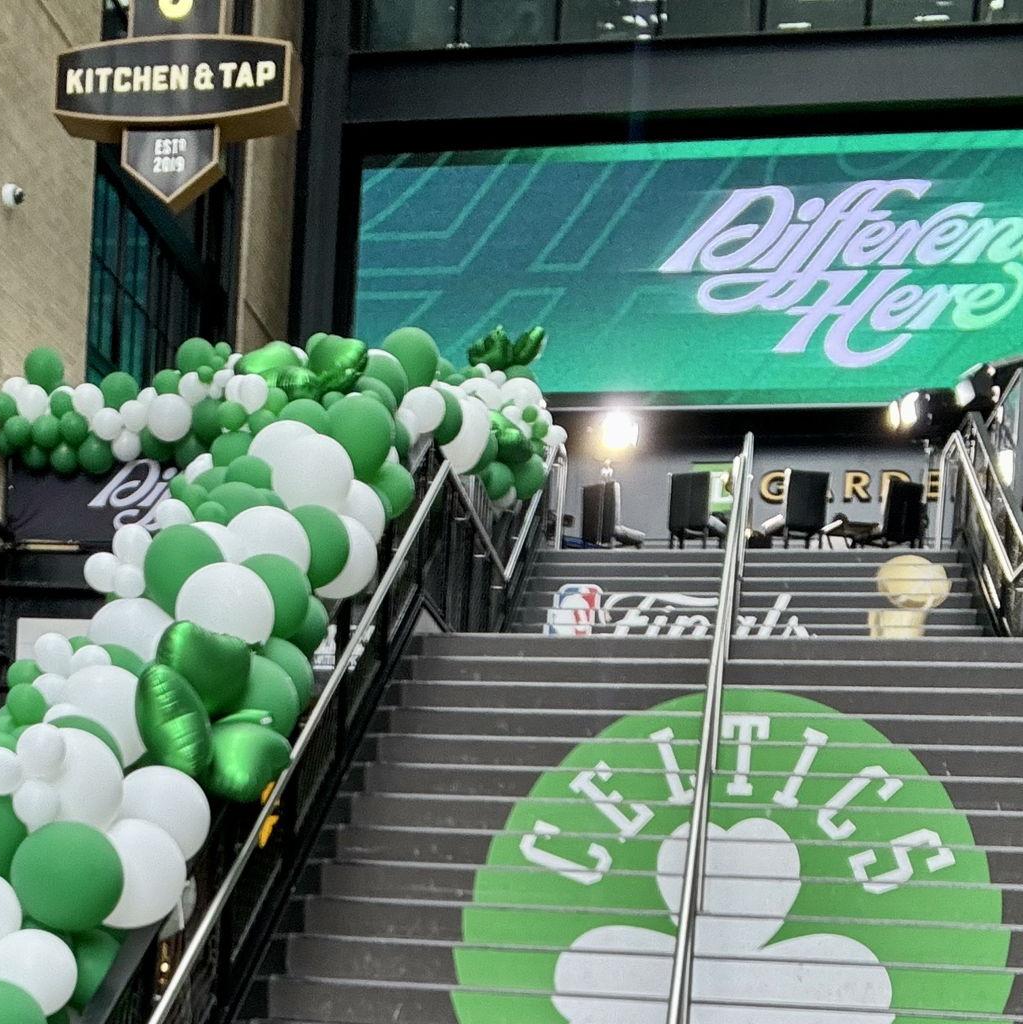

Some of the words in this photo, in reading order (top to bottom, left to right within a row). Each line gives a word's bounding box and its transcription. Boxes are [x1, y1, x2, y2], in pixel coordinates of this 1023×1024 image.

[66, 63, 188, 95] KITCHEN
[193, 62, 215, 91] &
[219, 60, 276, 89] TAP
[152, 156, 185, 173] 2019
[658, 178, 1023, 315] Differen
[771, 262, 1023, 368] Here
[519, 714, 955, 894] CELTICS
